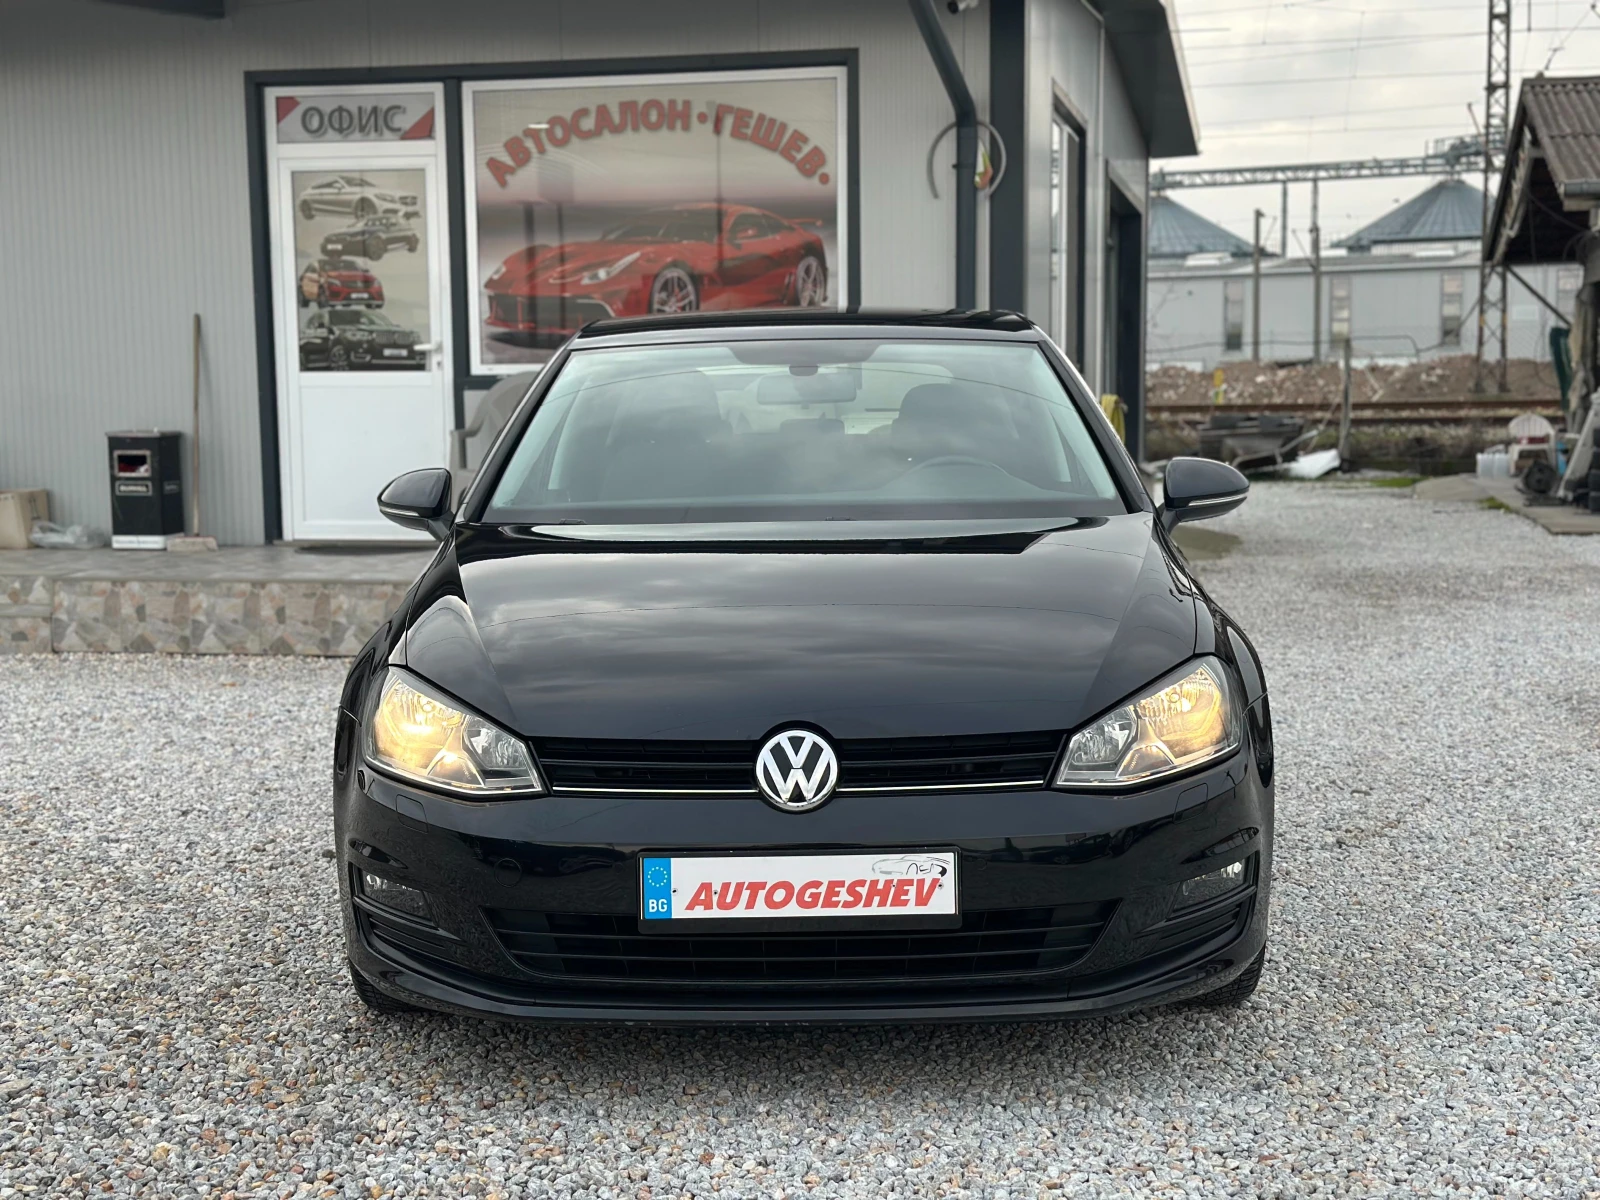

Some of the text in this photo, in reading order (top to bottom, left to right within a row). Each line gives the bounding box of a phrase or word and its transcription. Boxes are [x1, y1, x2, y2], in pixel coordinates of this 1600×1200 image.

[301, 105, 405, 136] ОФИС
[486, 99, 692, 188] АВТОСАЛОН
[648, 898, 668, 913] BG
[684, 878, 941, 911] AUTOGESHEV
